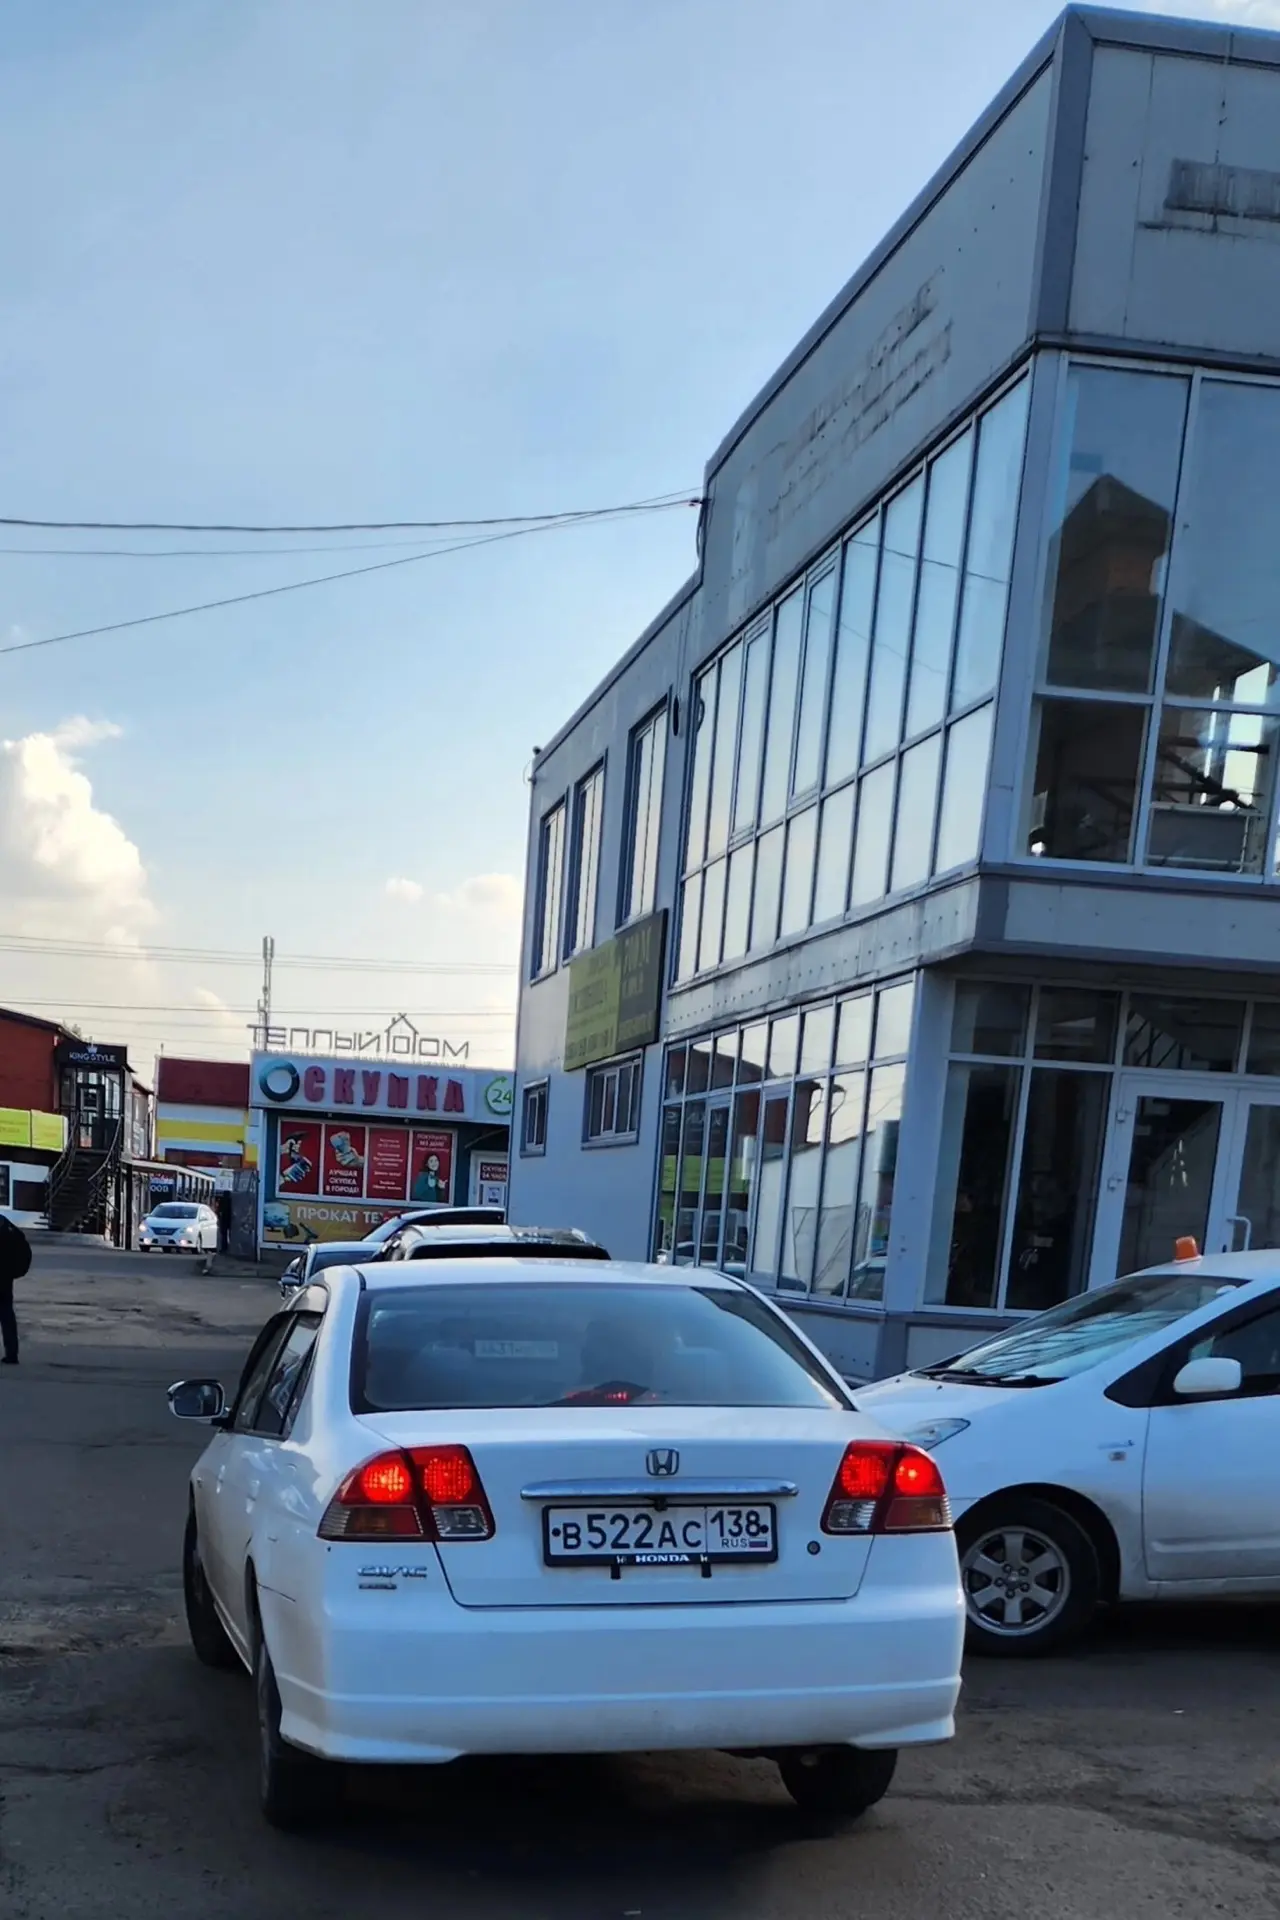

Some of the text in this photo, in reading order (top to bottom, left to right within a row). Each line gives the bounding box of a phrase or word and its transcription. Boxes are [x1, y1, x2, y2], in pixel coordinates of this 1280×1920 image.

[69, 1052, 116, 1062] KING STYLE
[304, 1065, 465, 1113] СКУПКА
[491, 1088, 512, 1105] 24
[328, 1177, 357, 1185] СКУПКА
[296, 1206, 359, 1223] ПРОКАТ
[710, 1510, 761, 1538] 138
[721, 1538, 748, 1548] RUS
[635, 1554, 690, 1563] HONDA
